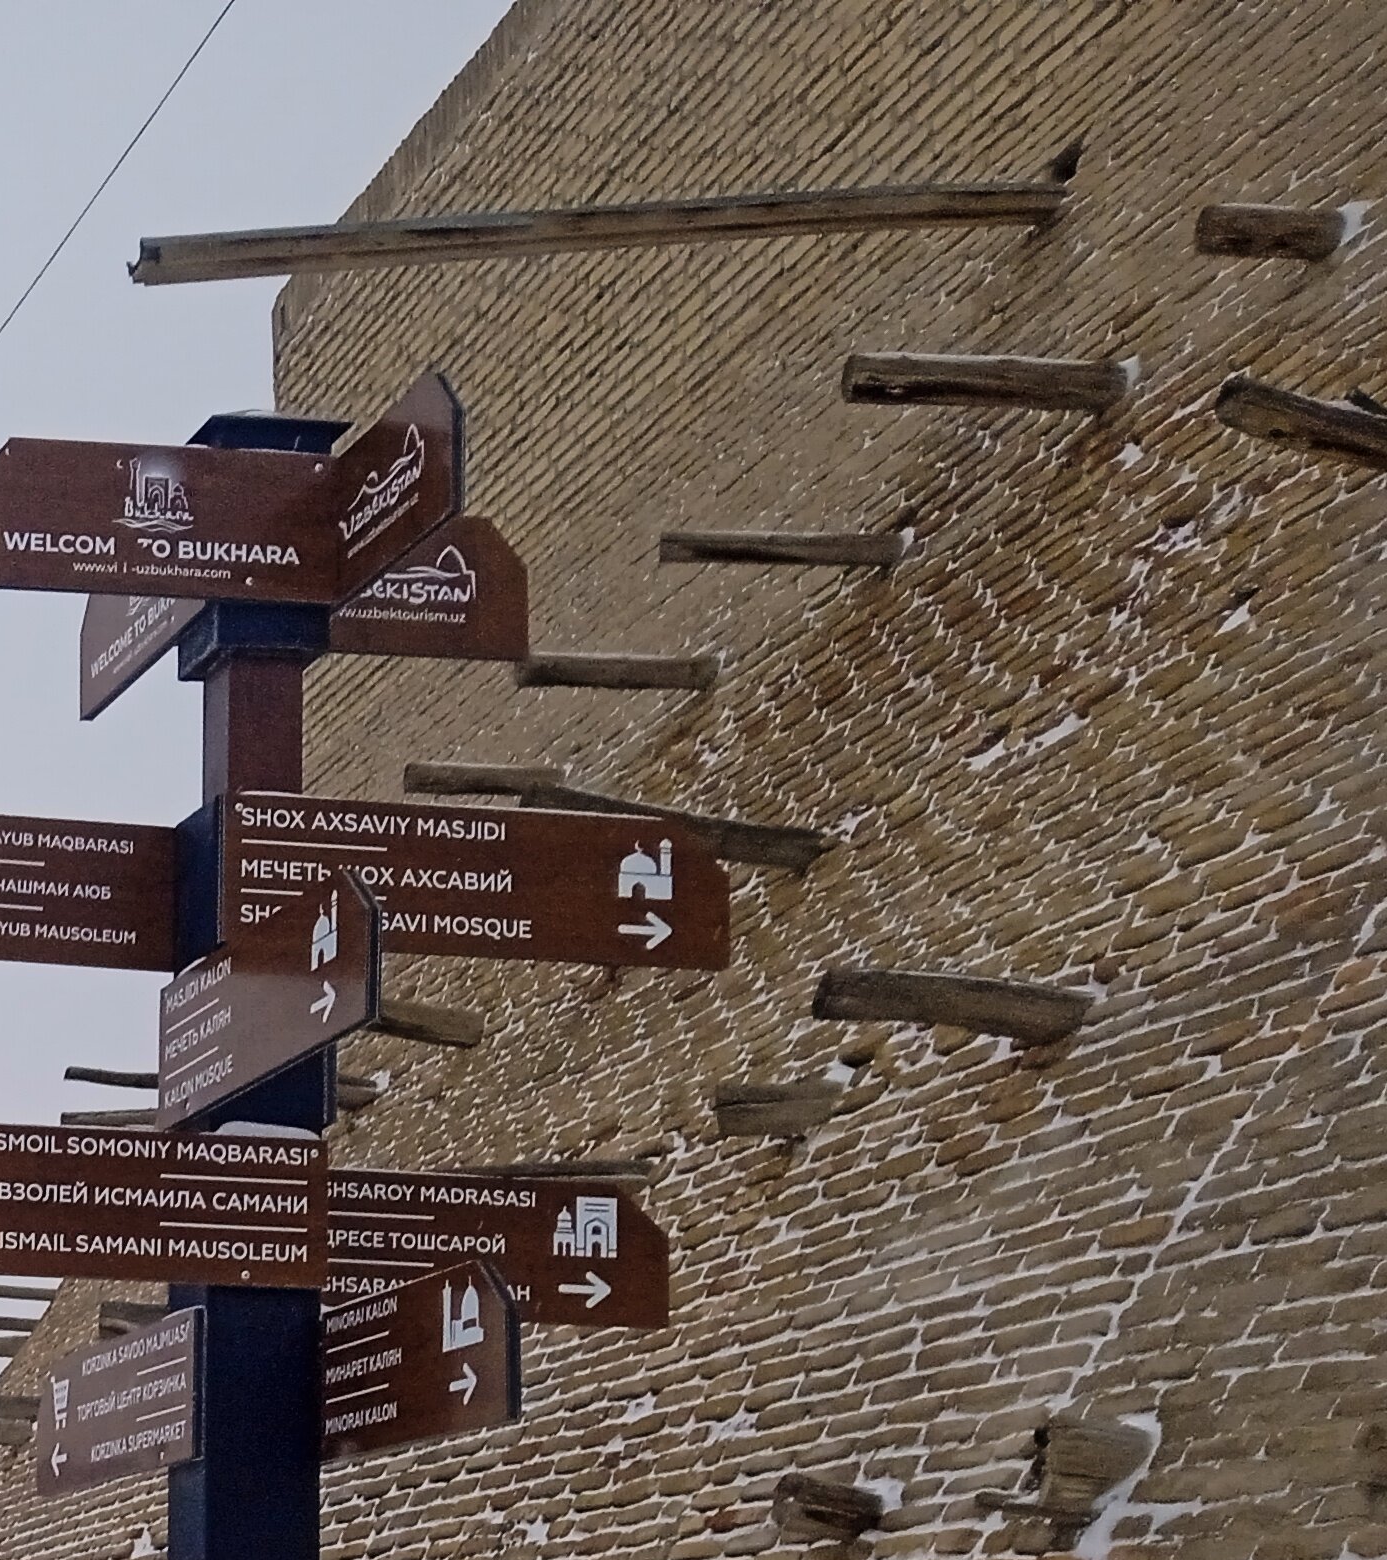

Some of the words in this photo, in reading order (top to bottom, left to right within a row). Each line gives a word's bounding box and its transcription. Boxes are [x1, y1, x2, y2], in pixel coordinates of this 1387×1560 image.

[125, 497, 194, 521] Bukhara
[339, 466, 421, 540] UZBEKISTAN
[3, 531, 115, 555] WELCOM
[178, 541, 300, 565] BUKHARA
[90, 626, 133, 678] WELCOME
[134, 614, 146, 637] TO
[240, 807, 305, 830] SHOX
[311, 812, 411, 835] AXSAVIY
[417, 818, 506, 841] MASJIDI
[37, 834, 135, 855] MAQBARASI
[72, 885, 112, 900] АЮБ
[240, 859, 331, 882] МЕЧЕТЬ
[338, 864, 395, 887] ОХ
[401, 869, 513, 893] АХСАВИЙ
[34, 925, 137, 944] MAUSOLEUM
[240, 904, 283, 924] SH
[433, 918, 532, 940] MOSQUE
[166, 980, 199, 1014] MASJIDI
[200, 957, 232, 992] KALON
[165, 1028, 198, 1062] МЕЧЕТЬ
[200, 1006, 232, 1041] КАЛЯН
[164, 1077, 195, 1109] KALON
[195, 1053, 233, 1091] MOSQUE
[67, 1137, 170, 1159] SOMONIY
[178, 1142, 308, 1166] MAQBARASI
[95, 1187, 206, 1210] ИСМАИЛА
[212, 1193, 308, 1214] САМАНИ
[421, 1186, 536, 1207] MADRASASI
[0, 1232, 71, 1252] ISMAIL
[76, 1235, 161, 1257] SAMANI
[168, 1239, 307, 1262] MAUSOLEUM
[389, 1232, 505, 1254] ТОШСАРОЙ
[326, 1307, 364, 1335] MINORAI
[365, 1296, 397, 1322] KALON
[82, 1349, 117, 1376] KORZINKA
[119, 1339, 144, 1363] SAVDO
[146, 1321, 190, 1352] MAJMUASI
[326, 1356, 369, 1385] МИНАРЕТ
[369, 1347, 402, 1372] КАЛЯН
[77, 1390, 115, 1421] ТОРГОВЫЙ
[117, 1386, 142, 1411] ЦЕНТР
[143, 1373, 186, 1400] КОРЗИНКА
[325, 1409, 364, 1435] MINORAI
[365, 1401, 397, 1425] KALON
[91, 1434, 127, 1463] KORZINKA
[128, 1420, 186, 1453] SUPERMARKET
